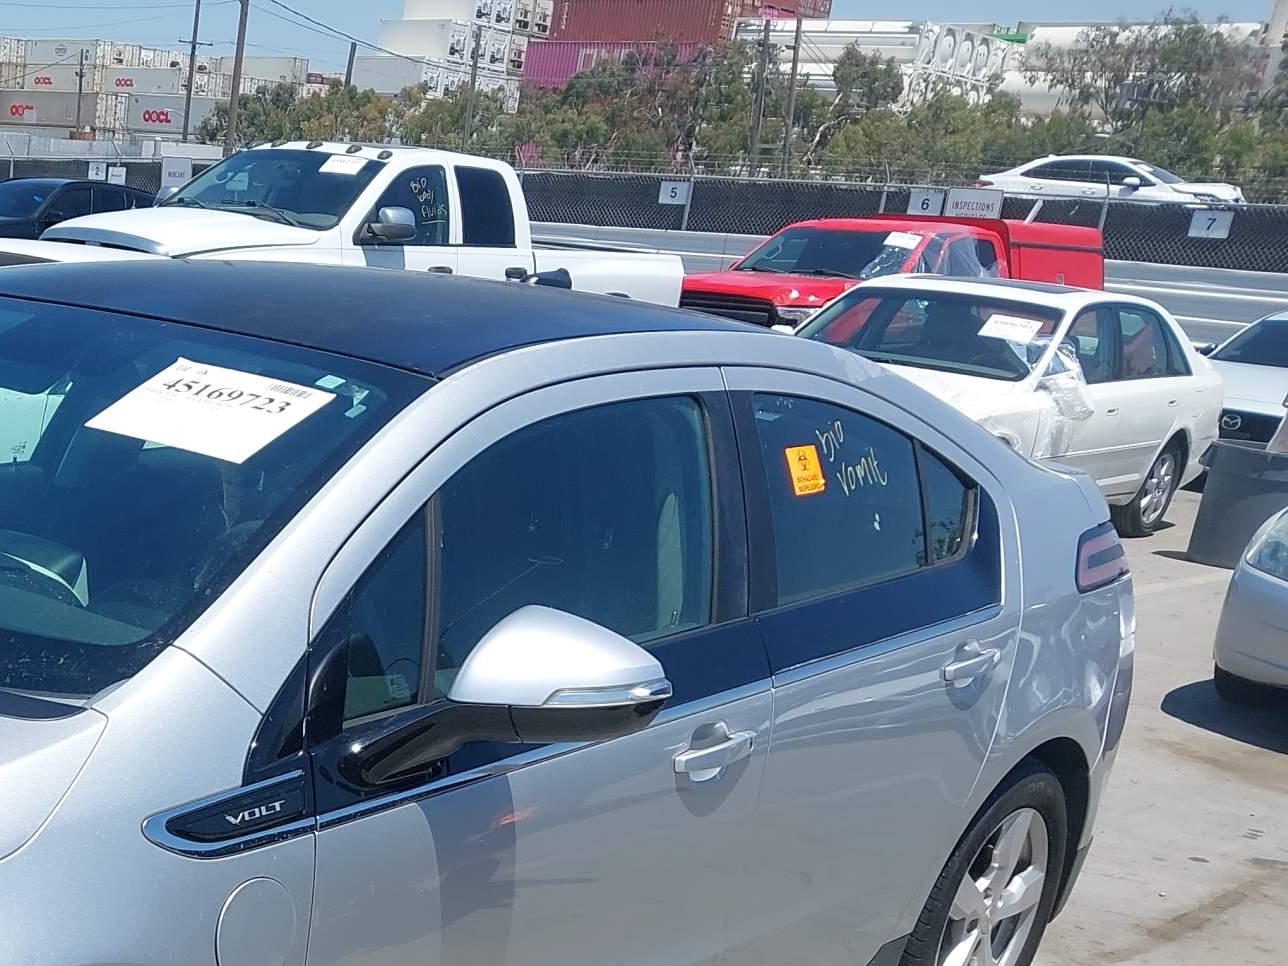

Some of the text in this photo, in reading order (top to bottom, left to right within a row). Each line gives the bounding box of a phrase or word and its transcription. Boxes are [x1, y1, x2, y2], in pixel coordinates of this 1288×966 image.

[34, 76, 53, 85] OOCL
[115, 78, 134, 87] OOCL
[143, 110, 171, 124] OOCL
[95, 167, 100, 176] 2
[670, 187, 678, 199] 5
[921, 198, 930, 211] 6
[951, 200, 995, 212] INSPECTIONS
[1206, 217, 1217, 231] 7
[163, 377, 292, 413] 45169723
[223, 800, 286, 826] VOLT
